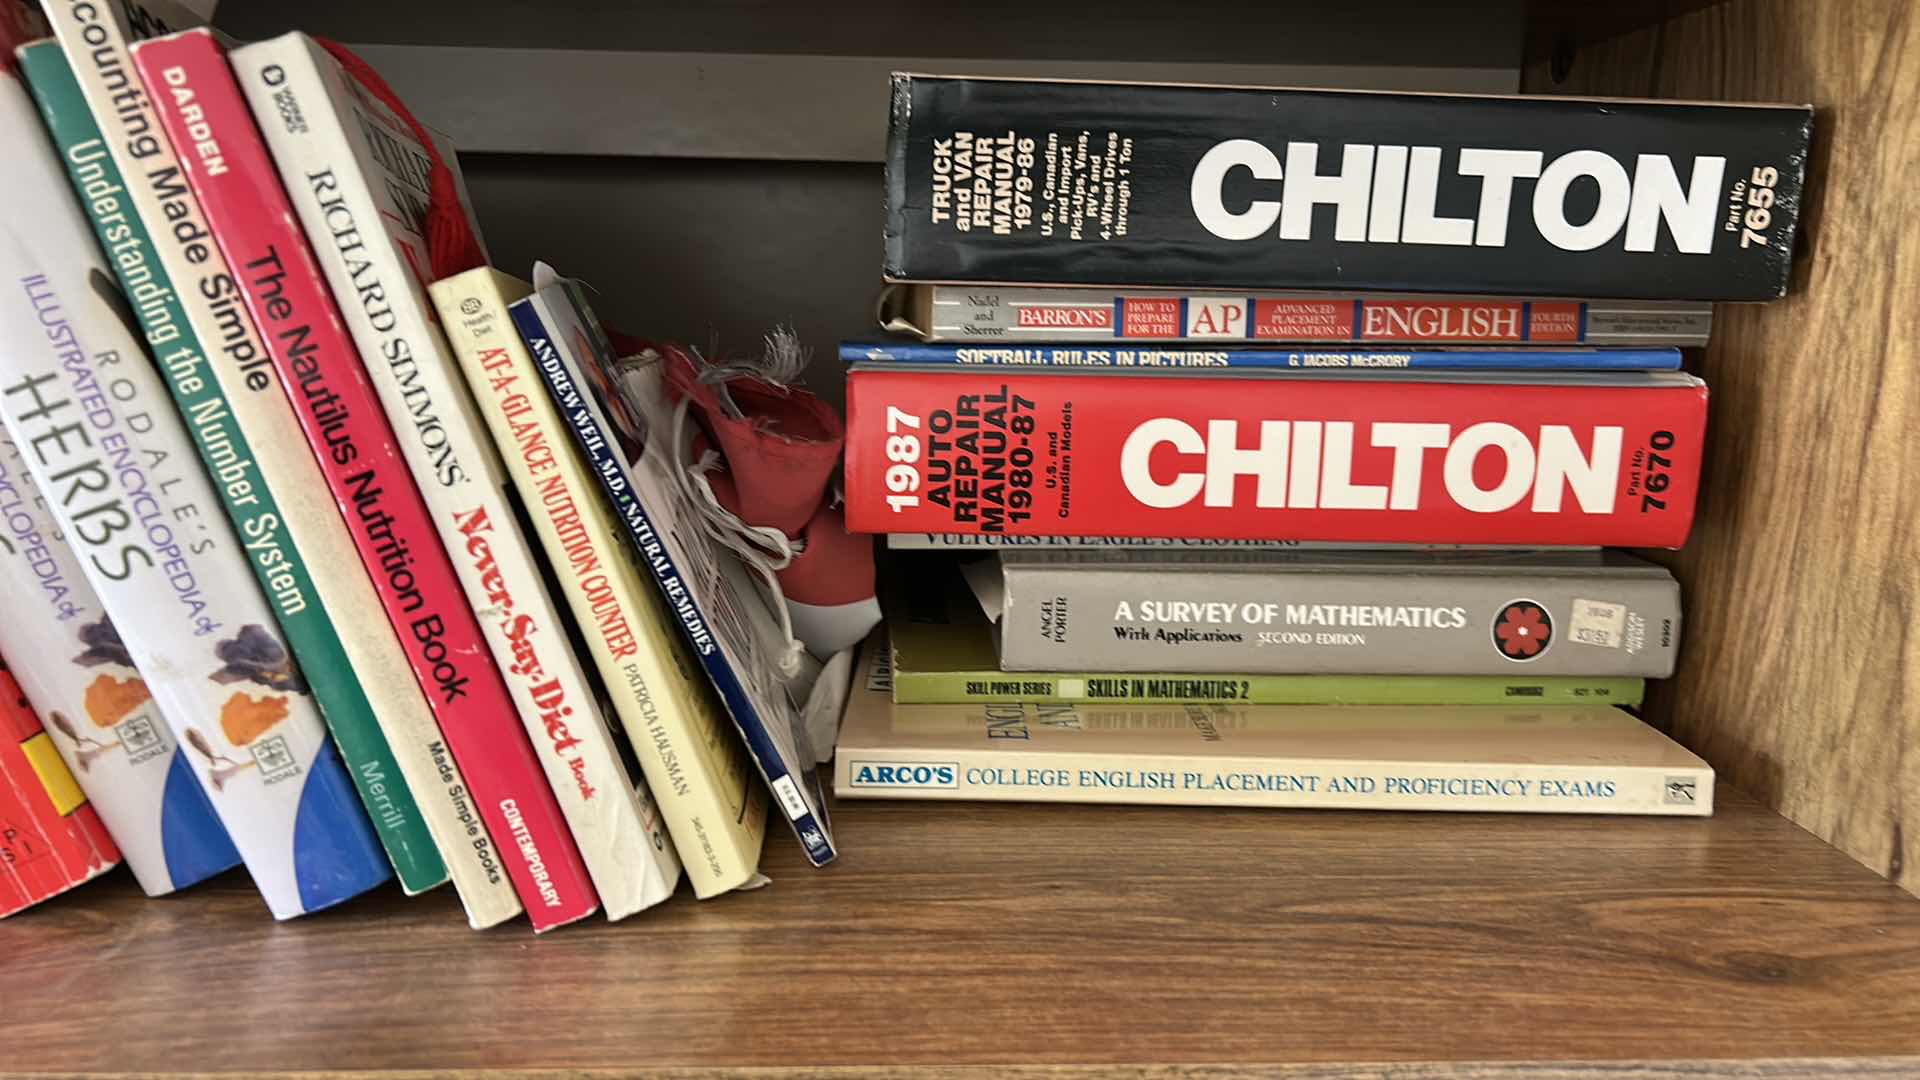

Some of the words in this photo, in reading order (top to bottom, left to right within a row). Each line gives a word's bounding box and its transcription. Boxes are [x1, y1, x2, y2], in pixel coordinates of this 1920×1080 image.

[163, 66, 228, 176] DARDEN
[955, 132, 974, 182] VAN
[1043, 132, 1058, 201] Canadian
[1059, 146, 1073, 195] Import
[1074, 130, 1091, 171] Vans,
[1090, 156, 1100, 184] and
[1105, 131, 1118, 179] Drives
[1120, 138, 1132, 162] Ton
[1120, 165, 1130, 173] 1
[70, 0, 161, 158] counting
[147, 165, 208, 263] Made
[200, 273, 270, 392] Simple
[932, 138, 952, 223] TRUCK
[973, 136, 994, 227] REPAIR
[993, 130, 1016, 235] MANUAL
[1014, 137, 1035, 227] 1979-86
[1087, 188, 1099, 217] RV's
[1191, 139, 1726, 254] CHILTON
[1728, 177, 1745, 199] No.
[956, 187, 972, 232] and
[1059, 199, 1069, 223] and
[1070, 174, 1088, 240] Pick-Ups,
[1100, 181, 1117, 240] 4-Wheel
[1115, 177, 1130, 235] through
[1725, 202, 1739, 233] Part
[1740, 166, 1779, 249] 7655
[308, 165, 396, 334] RICHARD
[974, 310, 993, 322] and
[1019, 308, 1107, 326] BARRON'S
[1127, 313, 1175, 323] PREPARE
[1127, 325, 1150, 334] FOR
[1152, 325, 1175, 335] THE
[1128, 303, 1153, 312] HOW
[1160, 303, 1175, 312] TO
[1192, 305, 1241, 333] AP
[1256, 325, 1331, 336] EXAMINATION
[1337, 326, 1350, 336] IN
[1272, 314, 1336, 325] PLACEMENT
[1274, 303, 1337, 315] ADVANCED
[1364, 306, 1519, 338] ENGLISH
[1530, 321, 1576, 333] EDITION
[1531, 312, 1576, 323] FOURTH
[68, 139, 182, 345] Understanding
[165, 347, 204, 394] the
[190, 397, 257, 507] Number
[242, 514, 306, 615] System
[1117, 351, 1135, 366] IN
[1139, 351, 1229, 367] PICTURES
[1351, 354, 1411, 368] McCRORY
[20, 273, 115, 430] ILLUSTRATED
[101, 433, 206, 622] ENCYCLOPEDIA
[1047, 431, 1057, 454] and
[1060, 402, 1072, 450] Models
[93, 348, 216, 555] RODALE'S
[247, 246, 291, 320] The
[279, 324, 358, 463] Nautilus
[346, 469, 424, 612] Nutrition
[414, 614, 469, 704] Book
[886, 406, 920, 512] 1987
[927, 410, 953, 508] AUTO
[954, 394, 980, 523] REPAIR
[981, 384, 1008, 532] MANUAL
[1008, 395, 1036, 523] 1980-87
[1046, 459, 1056, 488] U.S.
[1121, 418, 1623, 513] CHILTON
[1641, 430, 1674, 513] 7670
[4, 371, 155, 581] HERBS
[529, 337, 581, 409] ANDREW
[601, 457, 625, 496] M.D.
[622, 499, 667, 567] NATURAL
[664, 576, 716, 656] REMEDIES
[1058, 454, 1070, 518] Canadian
[1628, 470, 1640, 497] Part
[477, 347, 554, 476] AT-A-GLANCE
[539, 473, 597, 575] NUTRITION
[580, 570, 639, 661] COUNTER
[1041, 599, 1053, 638] ANGEL
[1055, 597, 1067, 643] PORTER
[1115, 602, 1134, 621] A
[1140, 602, 1236, 622] SURVEY
[1241, 603, 1278, 624] OF
[1286, 604, 1466, 629] MATHEMATICS
[1115, 627, 1150, 642] With
[1155, 627, 1243, 644] Applications
[1257, 631, 1312, 645] SECOND
[1316, 632, 1365, 645] EDITION
[966, 682, 990, 695] SKILL
[1023, 682, 1051, 696] SERIES
[1088, 680, 1128, 698] SKILLS
[1132, 680, 1144, 698] IN
[1149, 681, 1237, 698] MATHEMATICS
[1240, 683, 1250, 699] 2
[623, 663, 656, 731] PATRICIA
[649, 726, 691, 797] HAUSMAN
[359, 760, 408, 831] Merrill
[568, 756, 596, 801] Book
[855, 765, 953, 785] ARCO'S
[966, 768, 1070, 787] COLLEGE
[1079, 770, 1175, 789] ENGLISH
[1183, 771, 1318, 793] PLACEMENT
[1326, 776, 1375, 794] AND
[1386, 777, 1531, 797] PROFICIENCY
[1539, 780, 1616, 798] EXAMS
[429, 740, 453, 785] Made
[449, 784, 480, 838] Simple
[473, 834, 501, 885] Books
[500, 799, 561, 908] CONTEMPORARY
